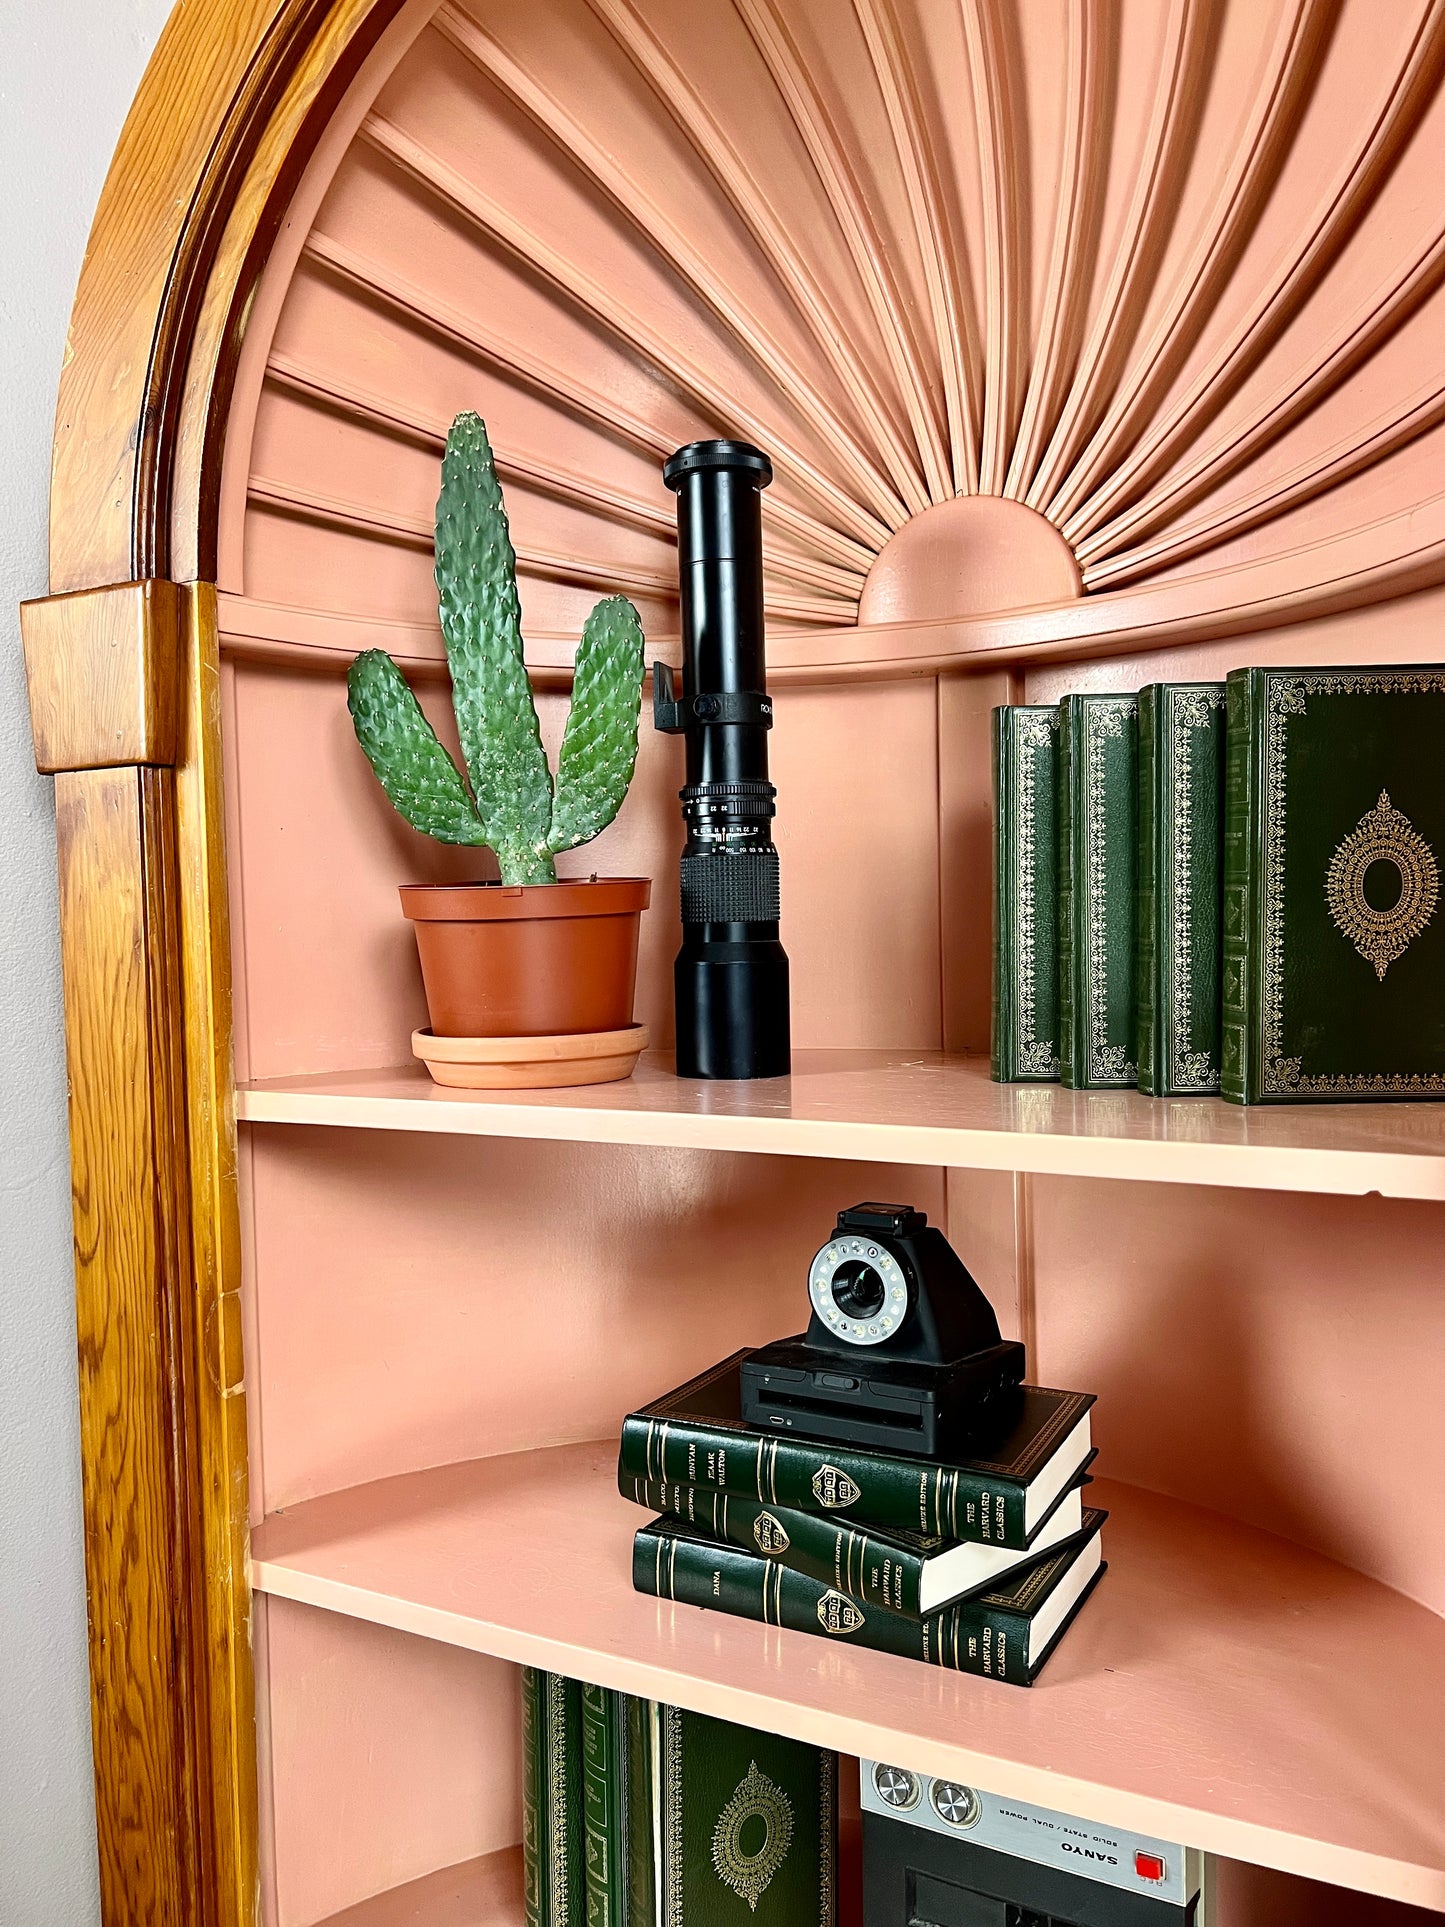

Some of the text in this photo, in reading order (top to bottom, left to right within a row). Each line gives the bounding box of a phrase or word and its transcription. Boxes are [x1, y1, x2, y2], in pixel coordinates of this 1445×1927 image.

[718, 1449, 726, 1486] WALTON
[920, 1471, 928, 1504] EDITION
[967, 1502, 975, 1523] THE
[981, 1491, 991, 1538] HARVARD
[995, 1495, 1005, 1540] CLASSICS
[835, 1531, 843, 1563] EDITION
[713, 1571, 721, 1597] DANA
[882, 1559, 891, 1606] HARVARD
[894, 1564, 903, 1609] CLASSICS
[922, 1635, 930, 1662] DELUXE
[968, 1636, 977, 1658] THE
[982, 1627, 992, 1674] HARVARD
[997, 1631, 1006, 1677] CLASSICS
[999, 1809, 1028, 1821] POWER
[1032, 1818, 1054, 1829] DUAL
[1063, 1827, 1088, 1839] STATE
[1093, 1836, 1118, 1847] SOLID
[1061, 1842, 1118, 1865] SANYO
